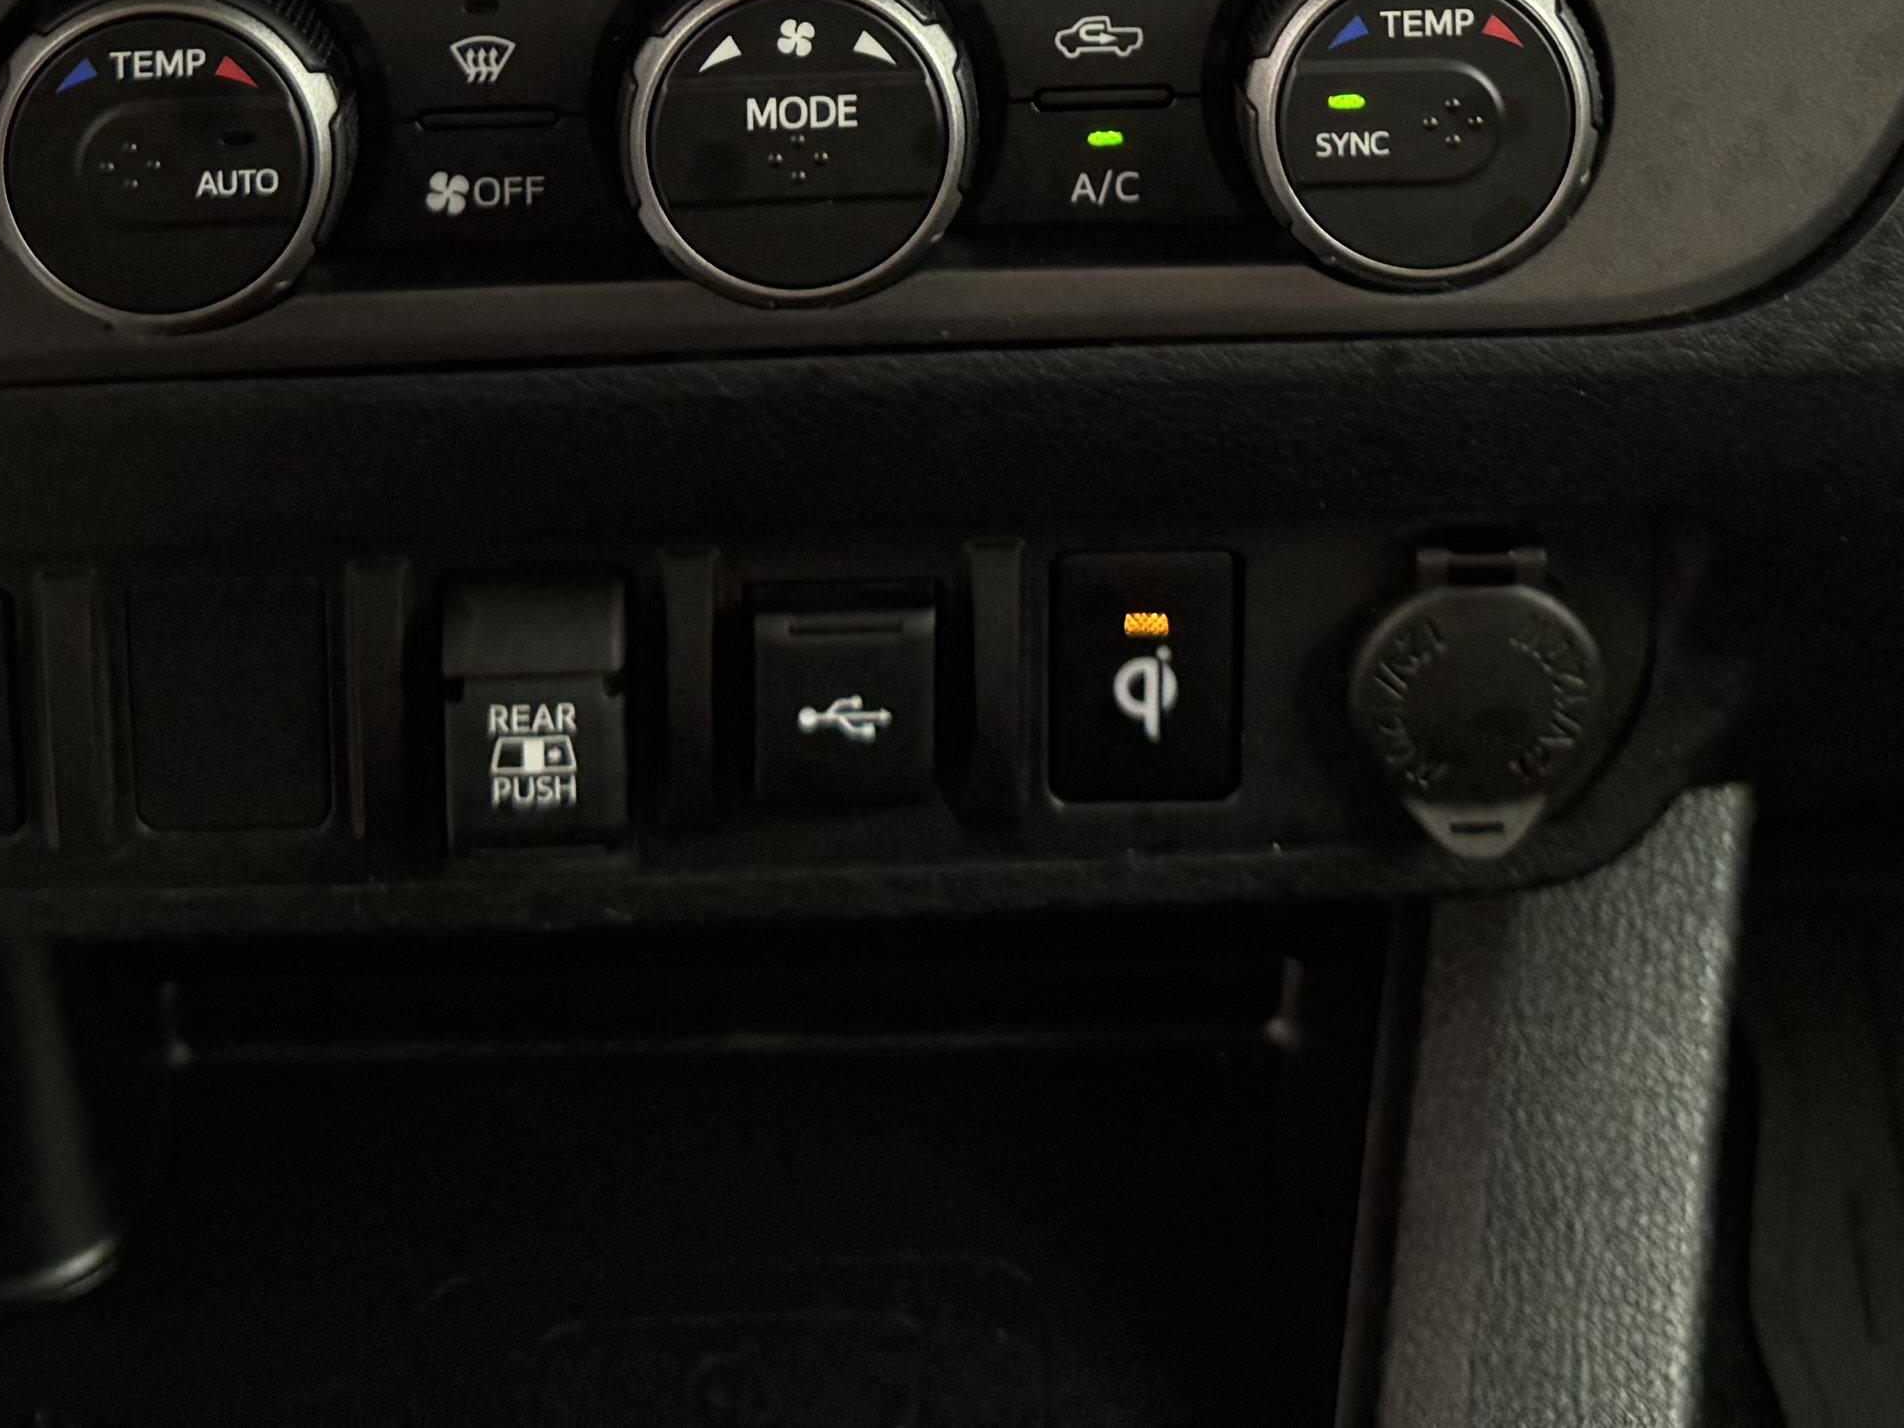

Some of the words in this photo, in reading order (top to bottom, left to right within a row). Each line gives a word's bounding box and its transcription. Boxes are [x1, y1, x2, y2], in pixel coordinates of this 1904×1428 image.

[1379, 8, 1475, 38] TEMP
[109, 48, 206, 80] TEMP
[745, 93, 859, 132] MODE
[1315, 130, 1390, 158] SYNC
[196, 168, 280, 197] AUTO
[473, 176, 545, 207] OFF
[1070, 169, 1140, 205] A/C
[487, 702, 577, 734] REAR
[492, 776, 577, 806] PUSH
